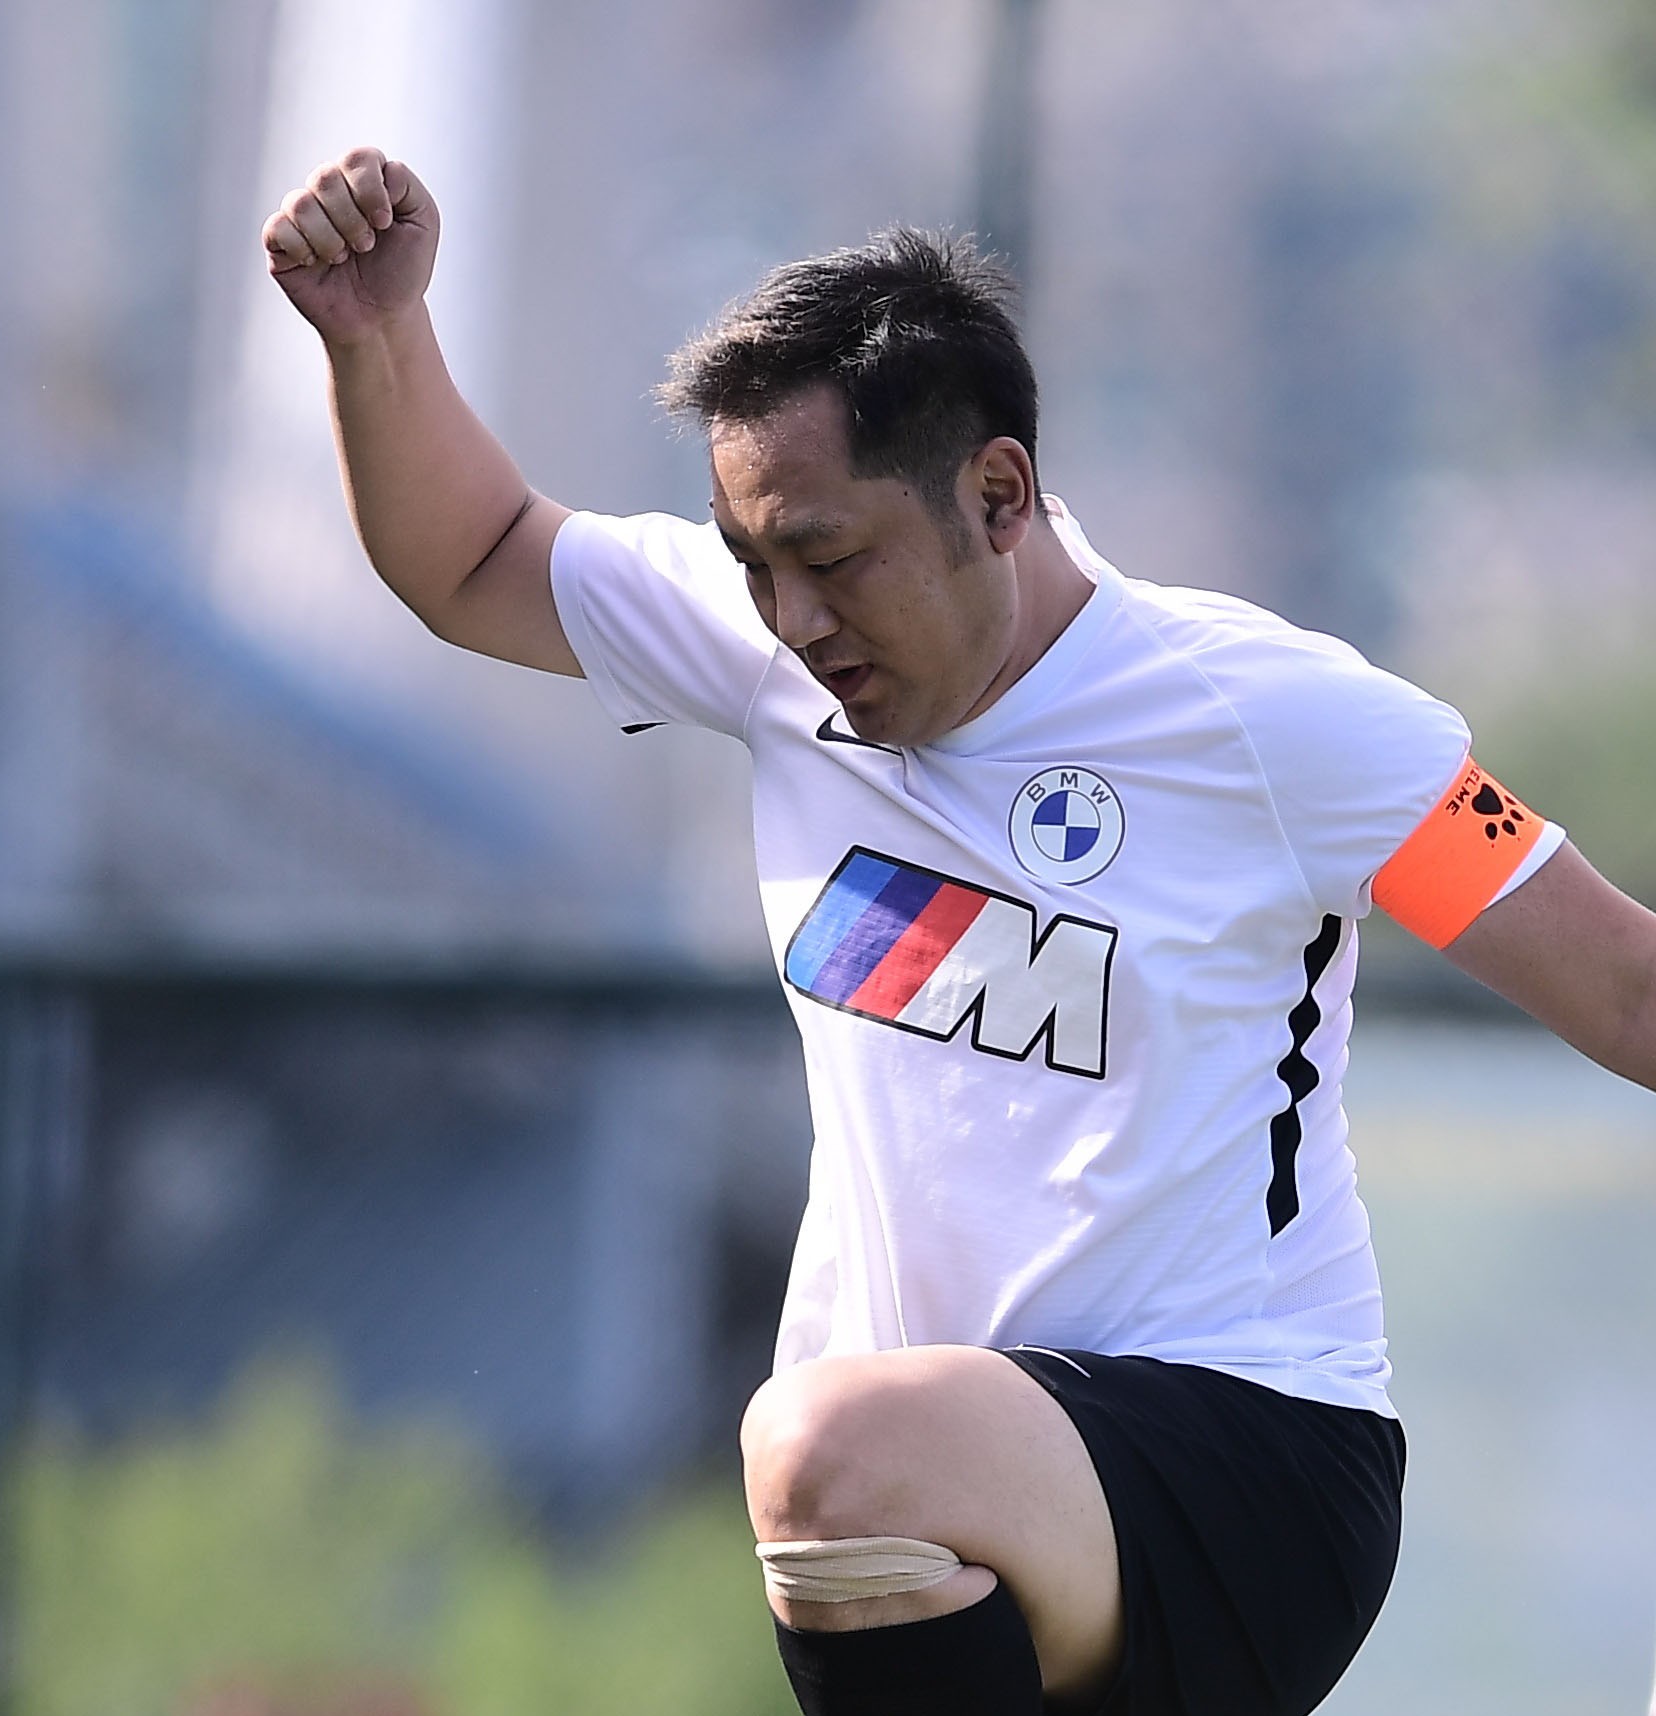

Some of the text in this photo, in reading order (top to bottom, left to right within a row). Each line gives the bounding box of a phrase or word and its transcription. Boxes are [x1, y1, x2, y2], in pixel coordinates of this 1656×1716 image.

[1025, 771, 1112, 805] BMW
[1445, 766, 1480, 817] ELME
[889, 892, 1119, 1081] M
